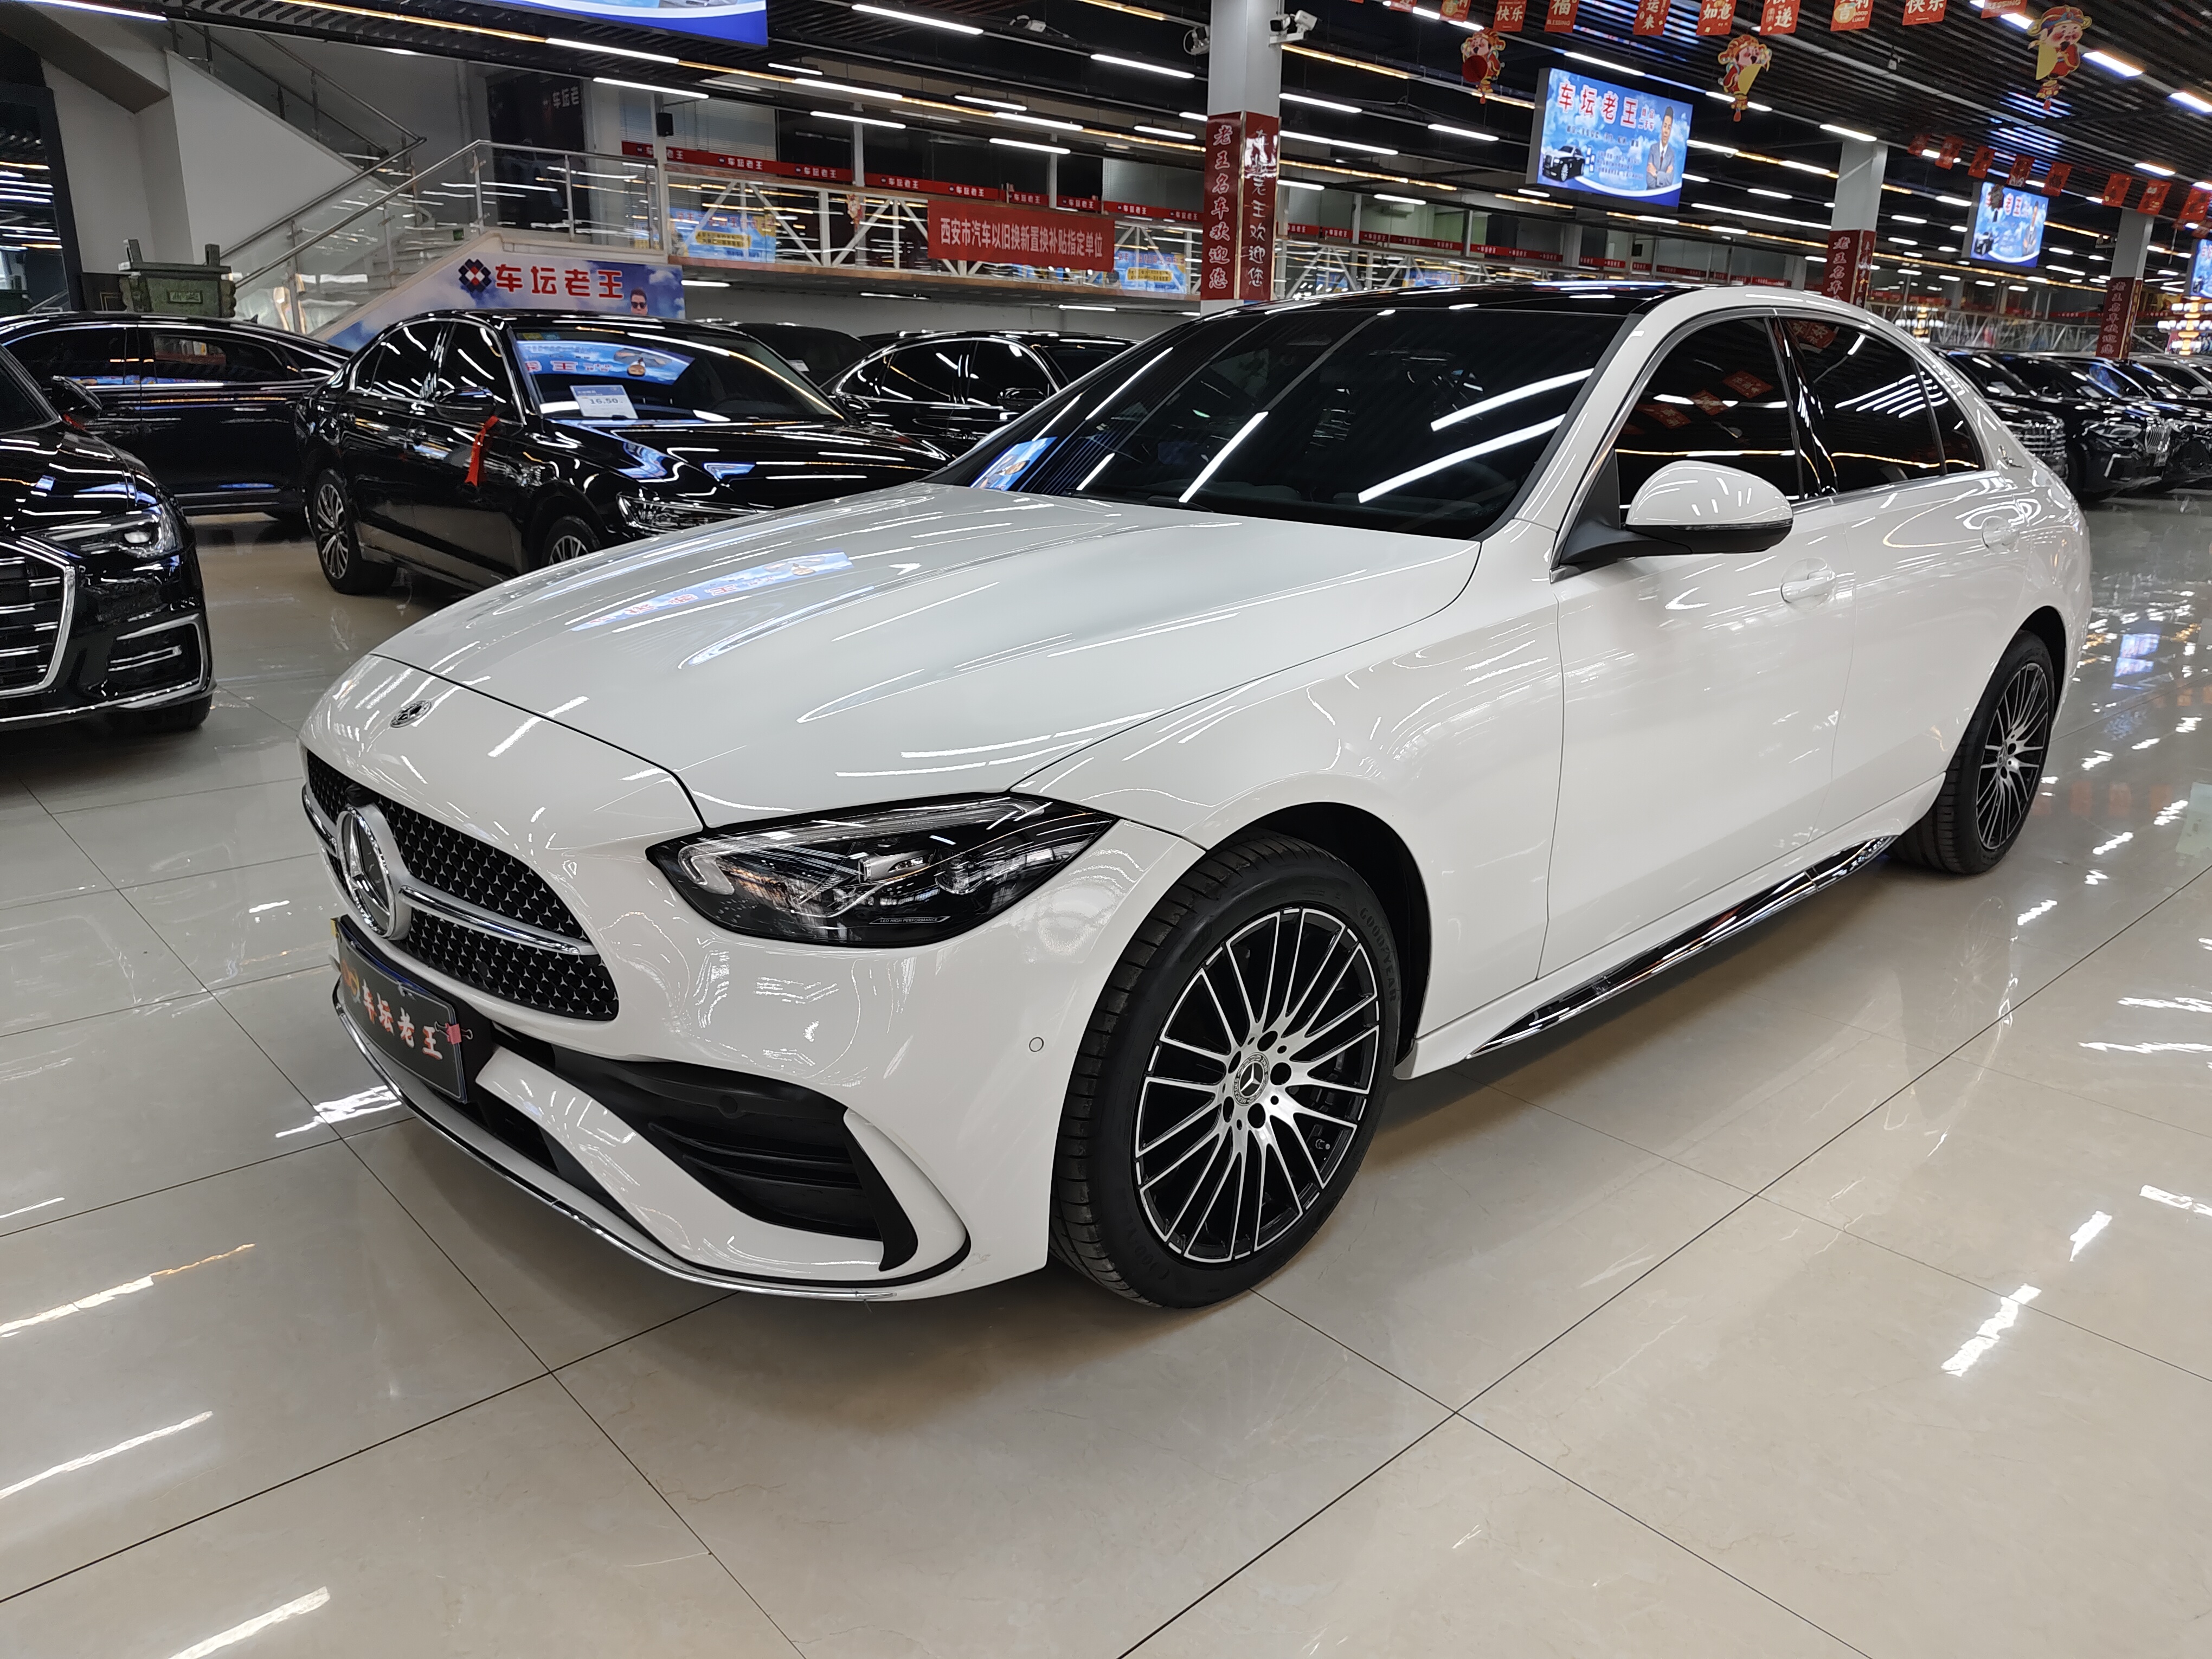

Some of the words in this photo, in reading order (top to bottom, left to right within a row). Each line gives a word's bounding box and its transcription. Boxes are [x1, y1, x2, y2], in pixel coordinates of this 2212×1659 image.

[1496, 5, 1523, 22] 快乐
[1551, 0, 1571, 15] 福
[1701, 3, 1732, 21] 如意
[1558, 82, 1638, 126] 车坛老王
[728, 157, 763, 170] 车坛老王
[803, 167, 837, 178] 车坛老王
[889, 178, 919, 189] 车坛老王
[956, 186, 985, 197] 车坛老王
[1208, 125, 1233, 289] 老王名车欢迎您
[940, 217, 1103, 259] 西安市汽车以旧换新置换补贴指定单位
[494, 263, 623, 299] 车坛老王
[1827, 236, 1851, 300] 老王名车
[1360, 908, 1397, 1001] GOODYEAR
[362, 979, 443, 1060] 车坛老王
